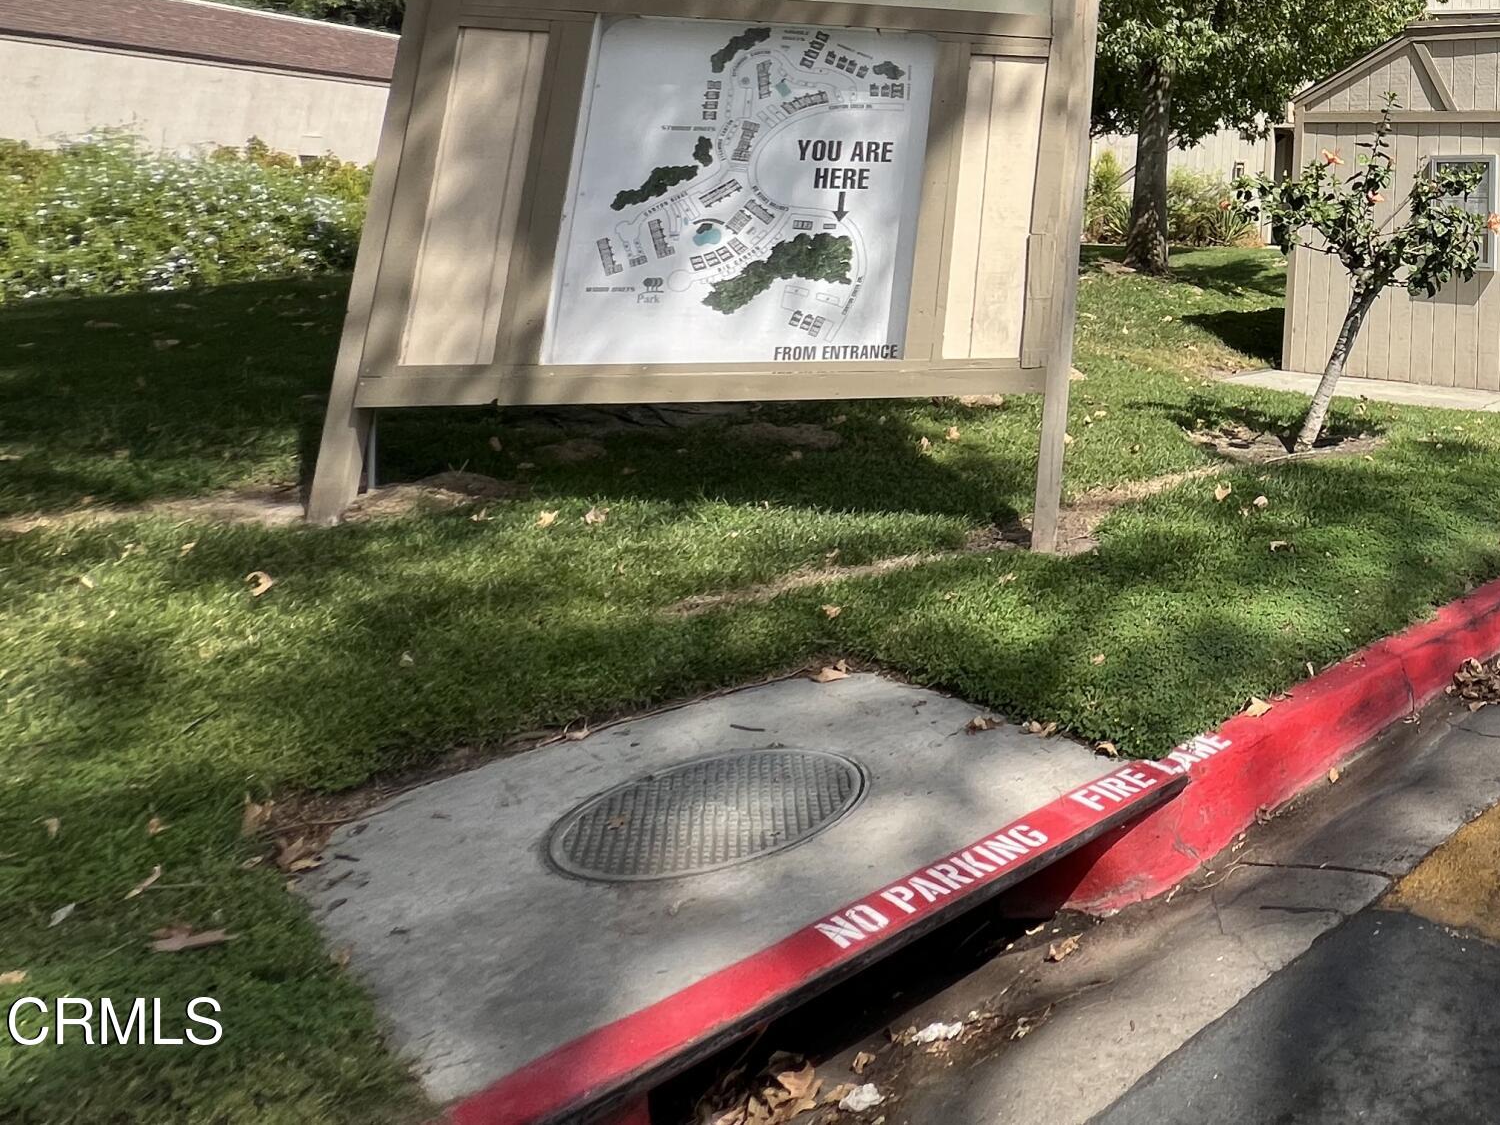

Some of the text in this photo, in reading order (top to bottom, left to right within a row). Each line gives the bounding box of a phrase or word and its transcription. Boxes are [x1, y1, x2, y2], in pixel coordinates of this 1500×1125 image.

[797, 139, 894, 163] YOU ARE
[813, 167, 870, 190] HERE
[636, 294, 661, 304] Park
[773, 344, 899, 361] FROM ENTRANCE
[814, 903, 890, 949] NO
[880, 824, 1049, 915] PARKING
[1069, 768, 1158, 812] FIRE
